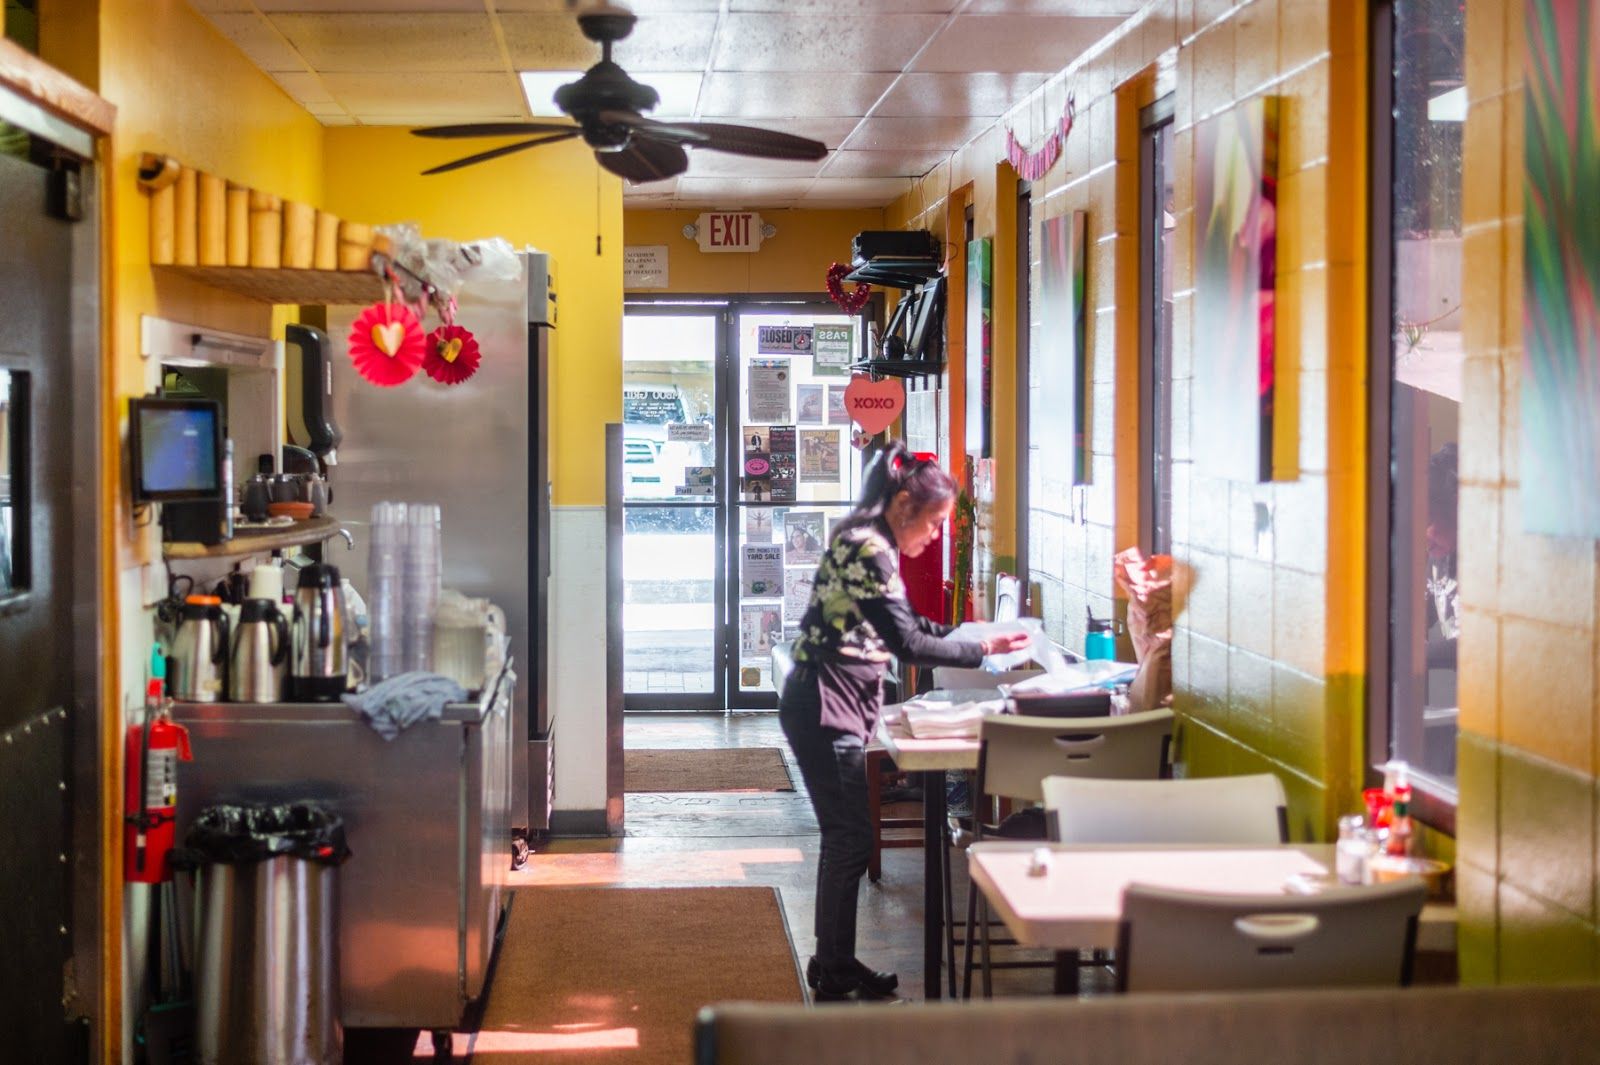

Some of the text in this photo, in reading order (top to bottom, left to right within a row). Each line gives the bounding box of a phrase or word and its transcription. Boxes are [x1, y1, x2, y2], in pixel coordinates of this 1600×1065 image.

[710, 214, 752, 246] EXIT
[760, 329, 793, 344] CLOSED
[853, 397, 895, 409] XOXO
[675, 487, 692, 495] Pull
